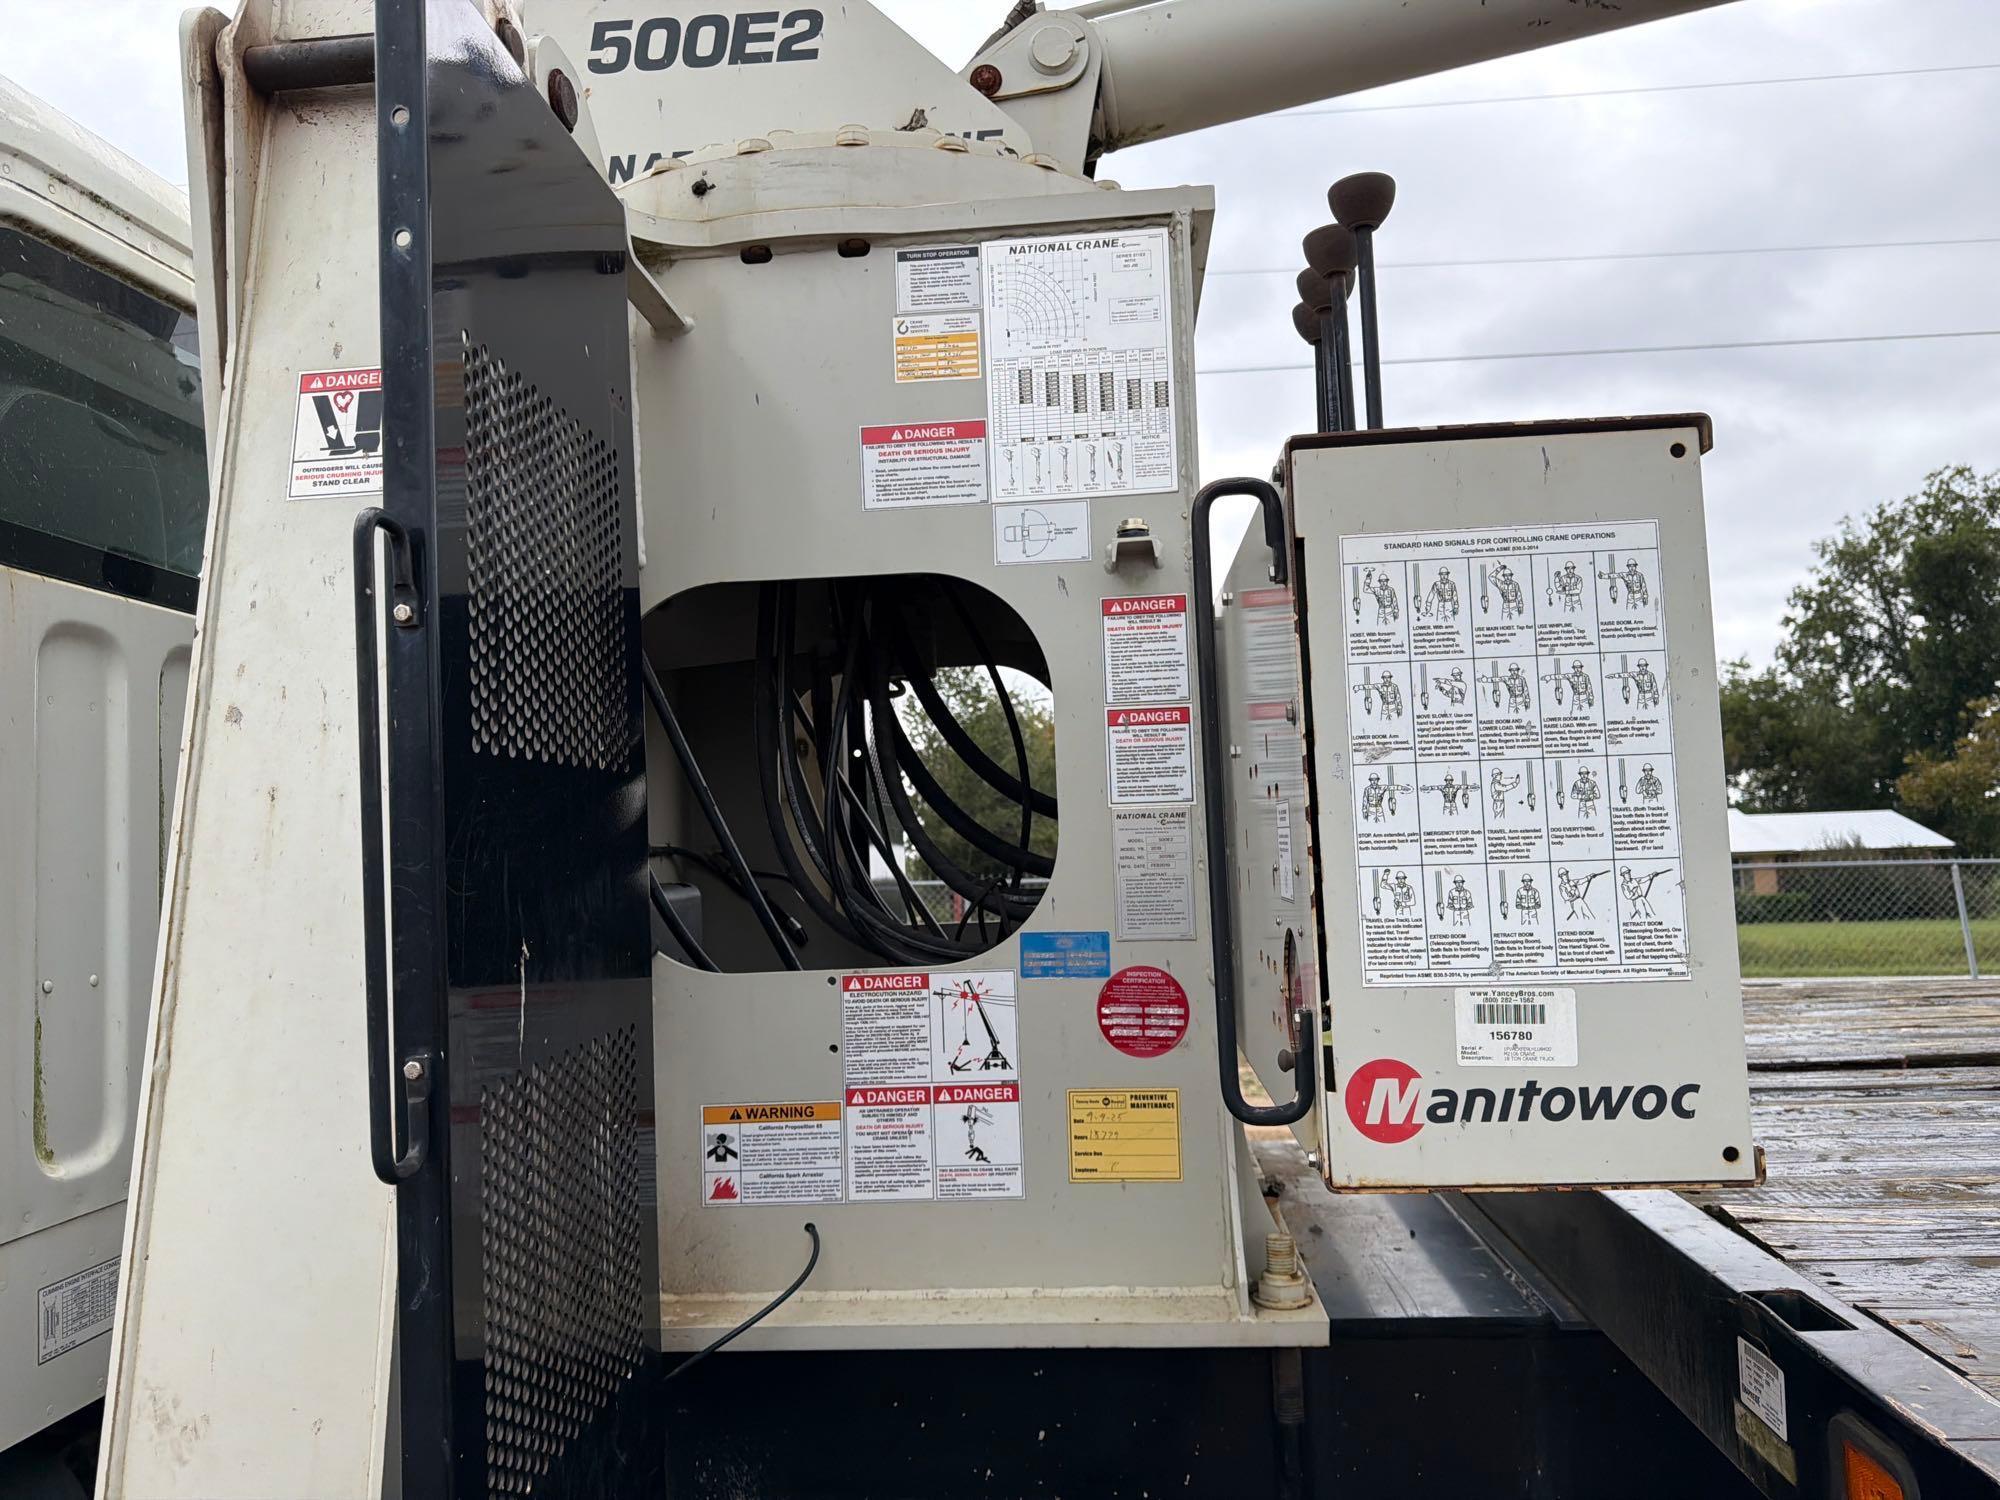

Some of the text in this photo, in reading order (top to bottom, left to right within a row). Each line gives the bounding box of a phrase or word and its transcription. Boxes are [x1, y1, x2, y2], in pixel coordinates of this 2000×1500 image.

[587, 9, 824, 74] 500E2
[1009, 239, 1119, 255] NATIONAL CRANE
[326, 372, 381, 387] DANGE
[905, 427, 955, 439] DANGER
[302, 465, 344, 474] OUTRIGGERS
[326, 471, 362, 479] CRUSHING
[312, 477, 370, 487] STAND CLEAR
[1384, 541, 1422, 550] STANDARD
[1423, 540, 1443, 548] HAND
[1445, 539, 1475, 547] SIGNALS
[1493, 536, 1543, 545] CONTROLLING
[1545, 534, 1569, 542] CRANE
[1571, 532, 1616, 541] OPERATIONS
[1123, 599, 1176, 611] DANGER
[1129, 711, 1181, 722] DANGER
[1116, 811, 1187, 820] NATIONAL CRANE
[864, 976, 921, 989] DANGER
[1469, 990, 1555, 998] www.YanceyBros.com
[1489, 1031, 1533, 1041] 156780
[867, 1090, 926, 1103] DANGER
[953, 1088, 1013, 1100] DANGER
[1365, 1078, 1700, 1125] Manitowoc
[745, 1106, 815, 1119] WARNING
[65, 1276, 80, 1287] ENGINE
[81, 1266, 103, 1280] INTERFACE
